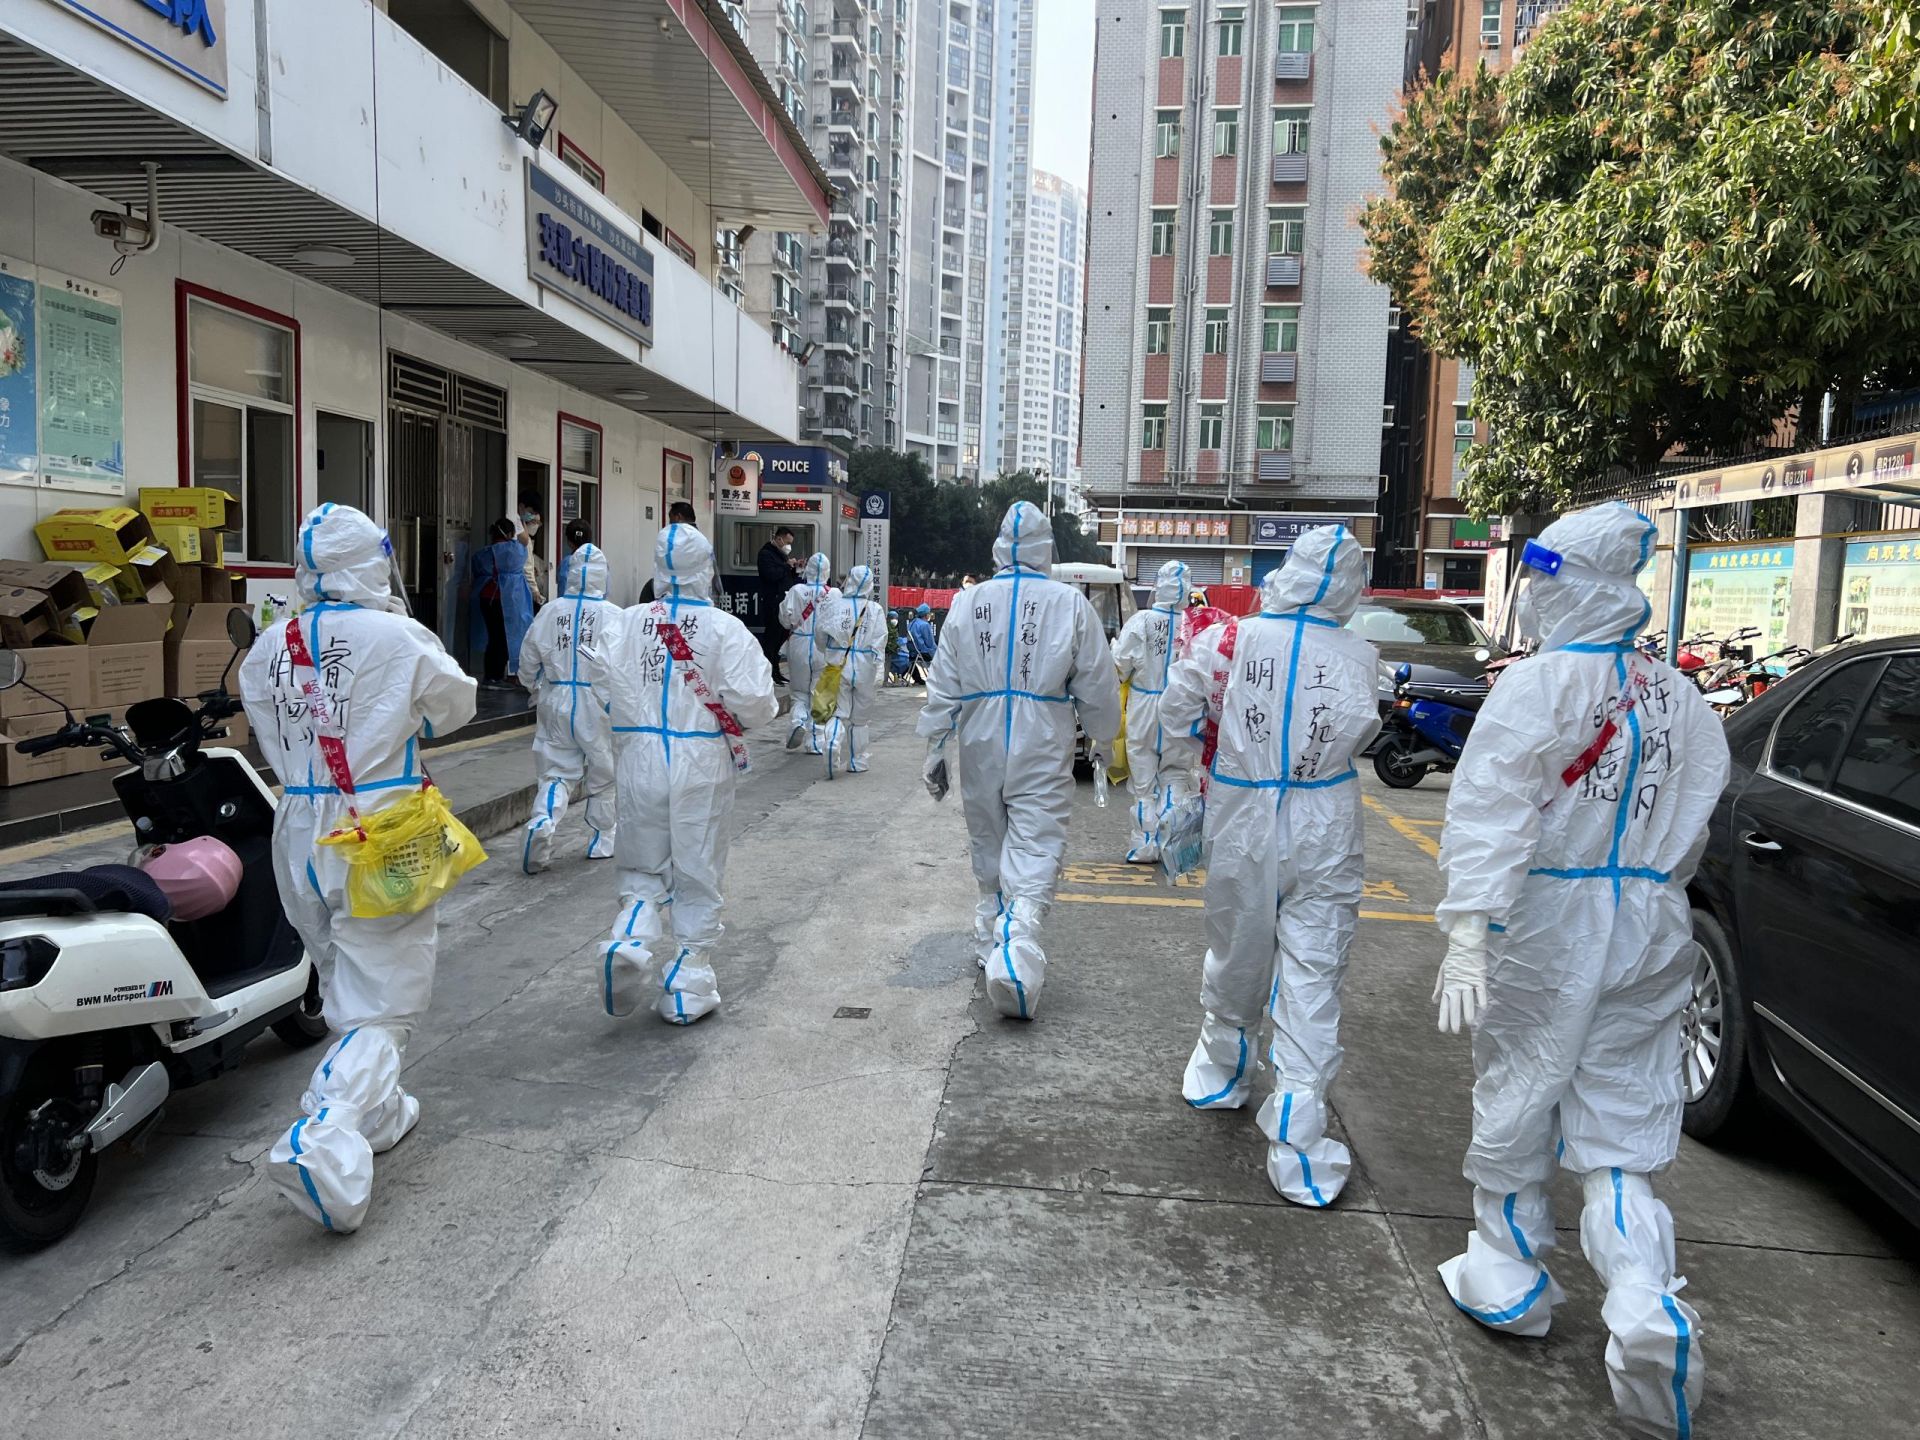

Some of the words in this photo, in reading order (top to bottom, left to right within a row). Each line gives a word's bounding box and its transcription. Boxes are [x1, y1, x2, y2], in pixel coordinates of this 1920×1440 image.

[772, 460, 809, 473] POLICE
[1852, 458, 1859, 477] 3
[1765, 475, 1772, 491] 2
[721, 489, 751, 500] 警务室
[1123, 519, 1230, 536] 杨记轮胎电池
[719, 592, 762, 617] 电话1
[557, 613, 573, 652] 明德
[975, 602, 996, 657] 明德
[1216, 671, 1230, 712] CAUTION
[1245, 657, 1271, 743] 明德
[311, 679, 330, 724] CAUTION
[76, 995, 101, 1006] BWM
[103, 990, 147, 1003] Motrsport
[113, 985, 138, 993] POWERED
